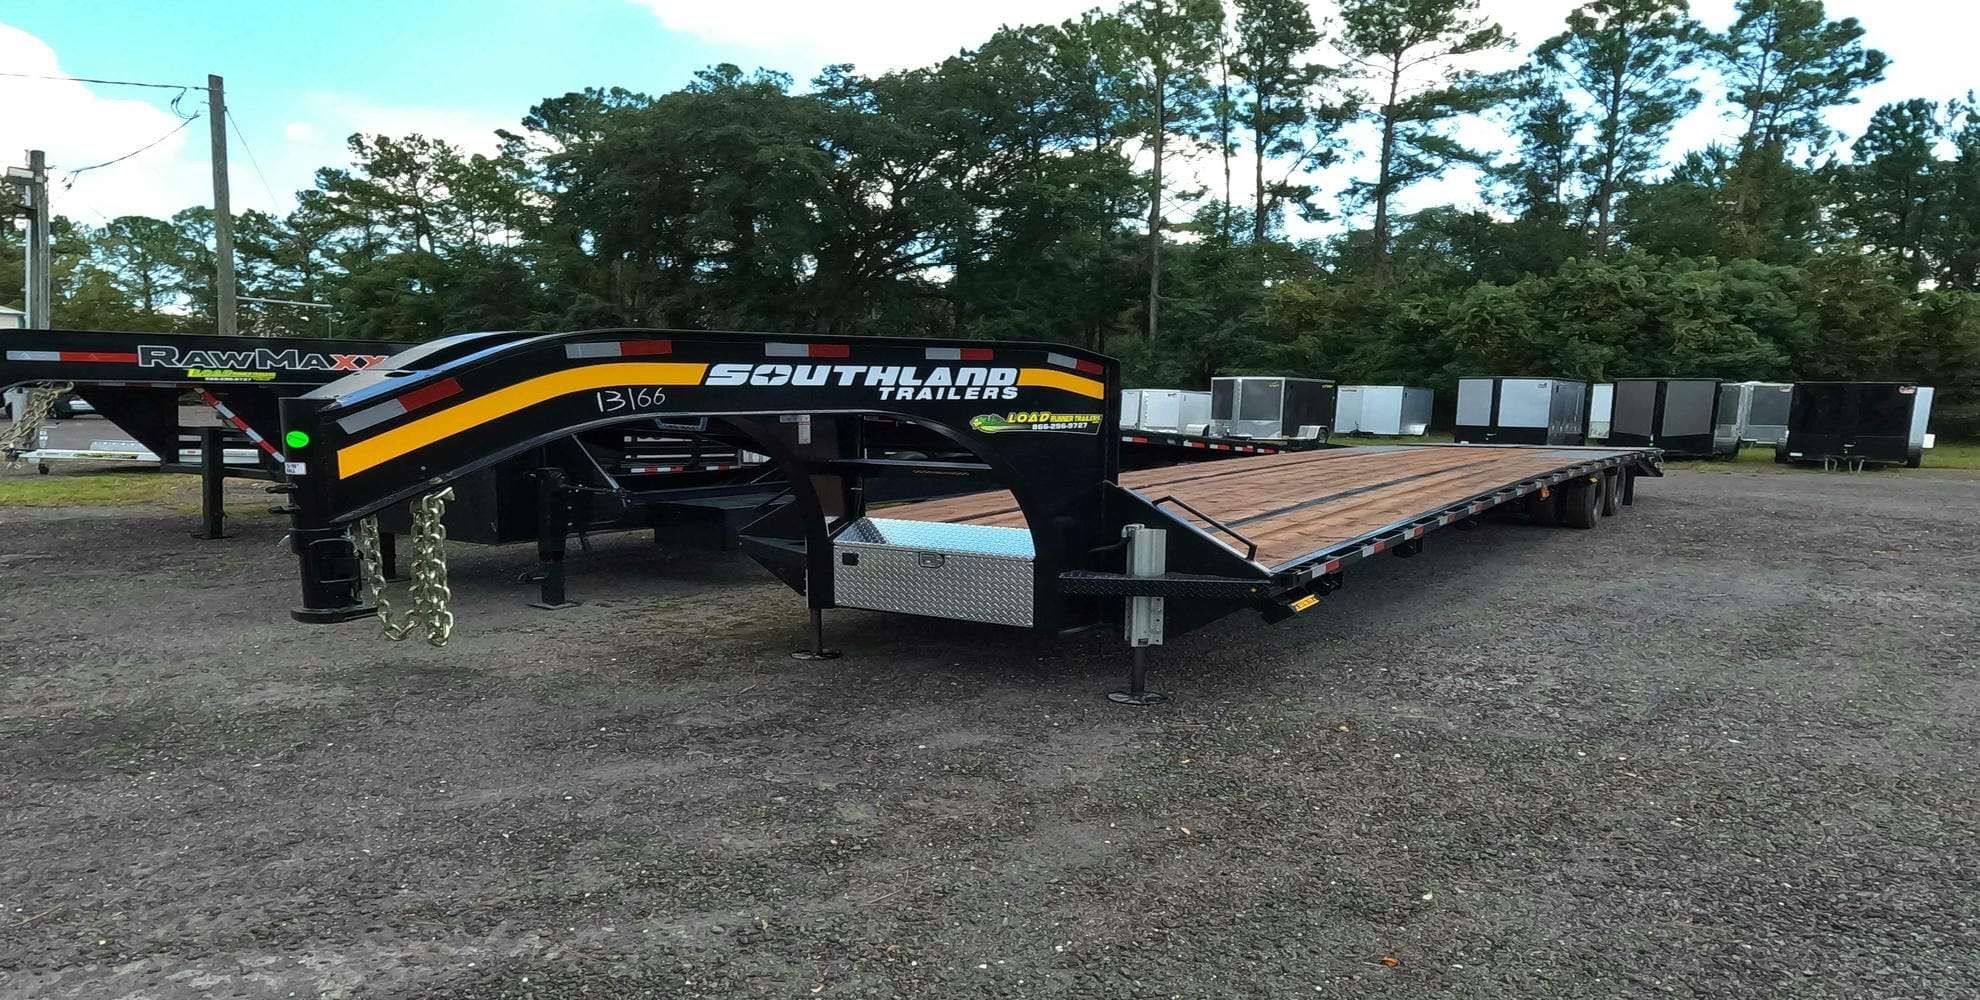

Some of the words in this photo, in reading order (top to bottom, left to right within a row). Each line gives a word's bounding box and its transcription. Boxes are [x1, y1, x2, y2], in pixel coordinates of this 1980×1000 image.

[705, 363, 1017, 386] SOUTHLAND
[596, 387, 666, 412] 13166
[879, 387, 1018, 401] TRAILERS
[1008, 412, 1050, 423] LOAD
